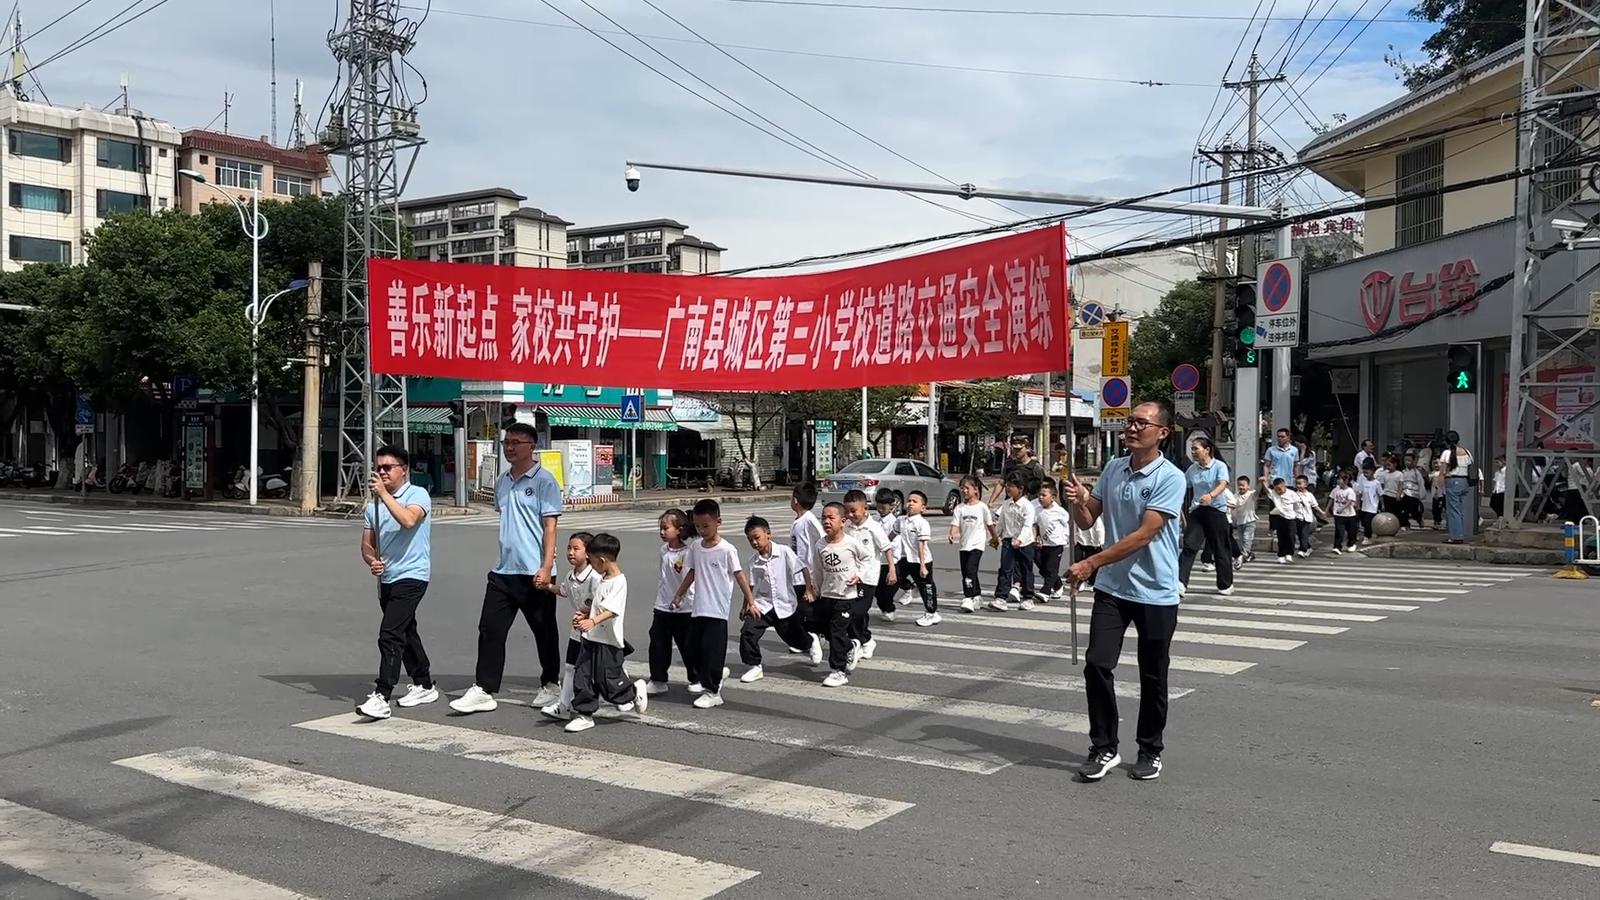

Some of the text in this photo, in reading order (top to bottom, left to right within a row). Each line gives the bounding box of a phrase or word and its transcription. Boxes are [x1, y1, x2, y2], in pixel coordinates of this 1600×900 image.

[1399, 258, 1480, 326] 台铃
[387, 279, 499, 361] 善乐新起点
[1268, 331, 1296, 343] 违停抓拍
[1269, 317, 1297, 328] 停车位外
